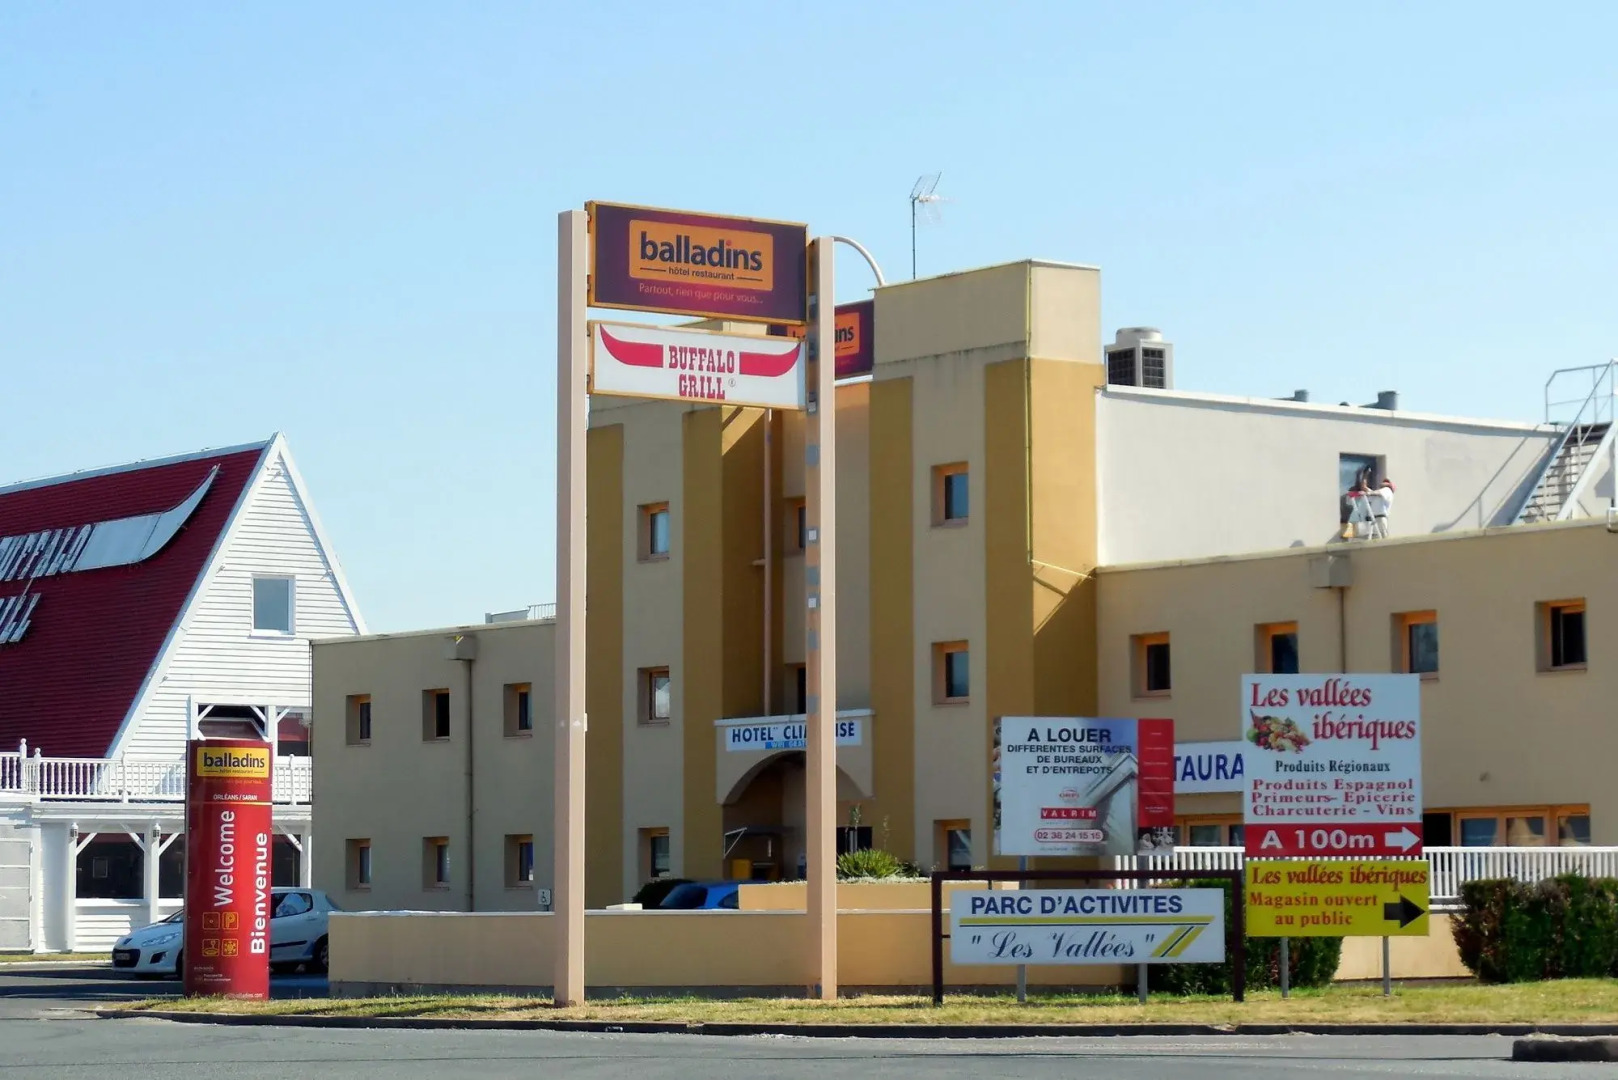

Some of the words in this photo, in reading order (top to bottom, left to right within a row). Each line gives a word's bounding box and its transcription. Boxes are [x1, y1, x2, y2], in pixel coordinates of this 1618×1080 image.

[640, 231, 763, 271] balladins
[668, 266, 690, 276] hôtel
[692, 270, 735, 280] restaurant
[640, 283, 673, 297] Partout,
[669, 345, 735, 374] BUFFALO
[679, 374, 725, 400] GRILL
[1250, 682, 1288, 708] Les
[1297, 678, 1371, 708] vallées
[732, 727, 774, 743] HOTEL
[1027, 728, 1040, 742] A
[1047, 728, 1112, 742] LOUER
[1313, 711, 1415, 750] ibériques
[1007, 745, 1076, 753] DIFFERENTES
[1078, 745, 1132, 753] SURFACES
[203, 752, 265, 768] balladins
[1275, 760, 1326, 772] Produits
[1329, 760, 1391, 774] Régionaux
[1026, 766, 1039, 774] ET
[1042, 766, 1112, 774] D'ENTREPOTS
[1253, 779, 1328, 790] Produits
[1334, 779, 1413, 792] Espagnol
[1344, 792, 1416, 805] Epicerie
[1253, 805, 1357, 816] Charcuterie
[1377, 804, 1414, 816] Vins
[1260, 830, 1283, 849] A
[1295, 829, 1375, 849] 100m
[214, 810, 236, 907] Welcome
[1252, 866, 1281, 884] Les
[1287, 864, 1344, 885] vallées
[1350, 864, 1427, 892] ibériques
[250, 832, 268, 954] Bienvenue
[1250, 892, 1319, 908] Magasin
[1325, 895, 1378, 906] ouvert
[971, 896, 1033, 914] PARC
[1040, 895, 1184, 914] D'ACTIVITES
[1275, 915, 1294, 925] au
[1301, 911, 1353, 927] public
[988, 930, 1033, 958] Les
[1048, 930, 1135, 958] Vallées
